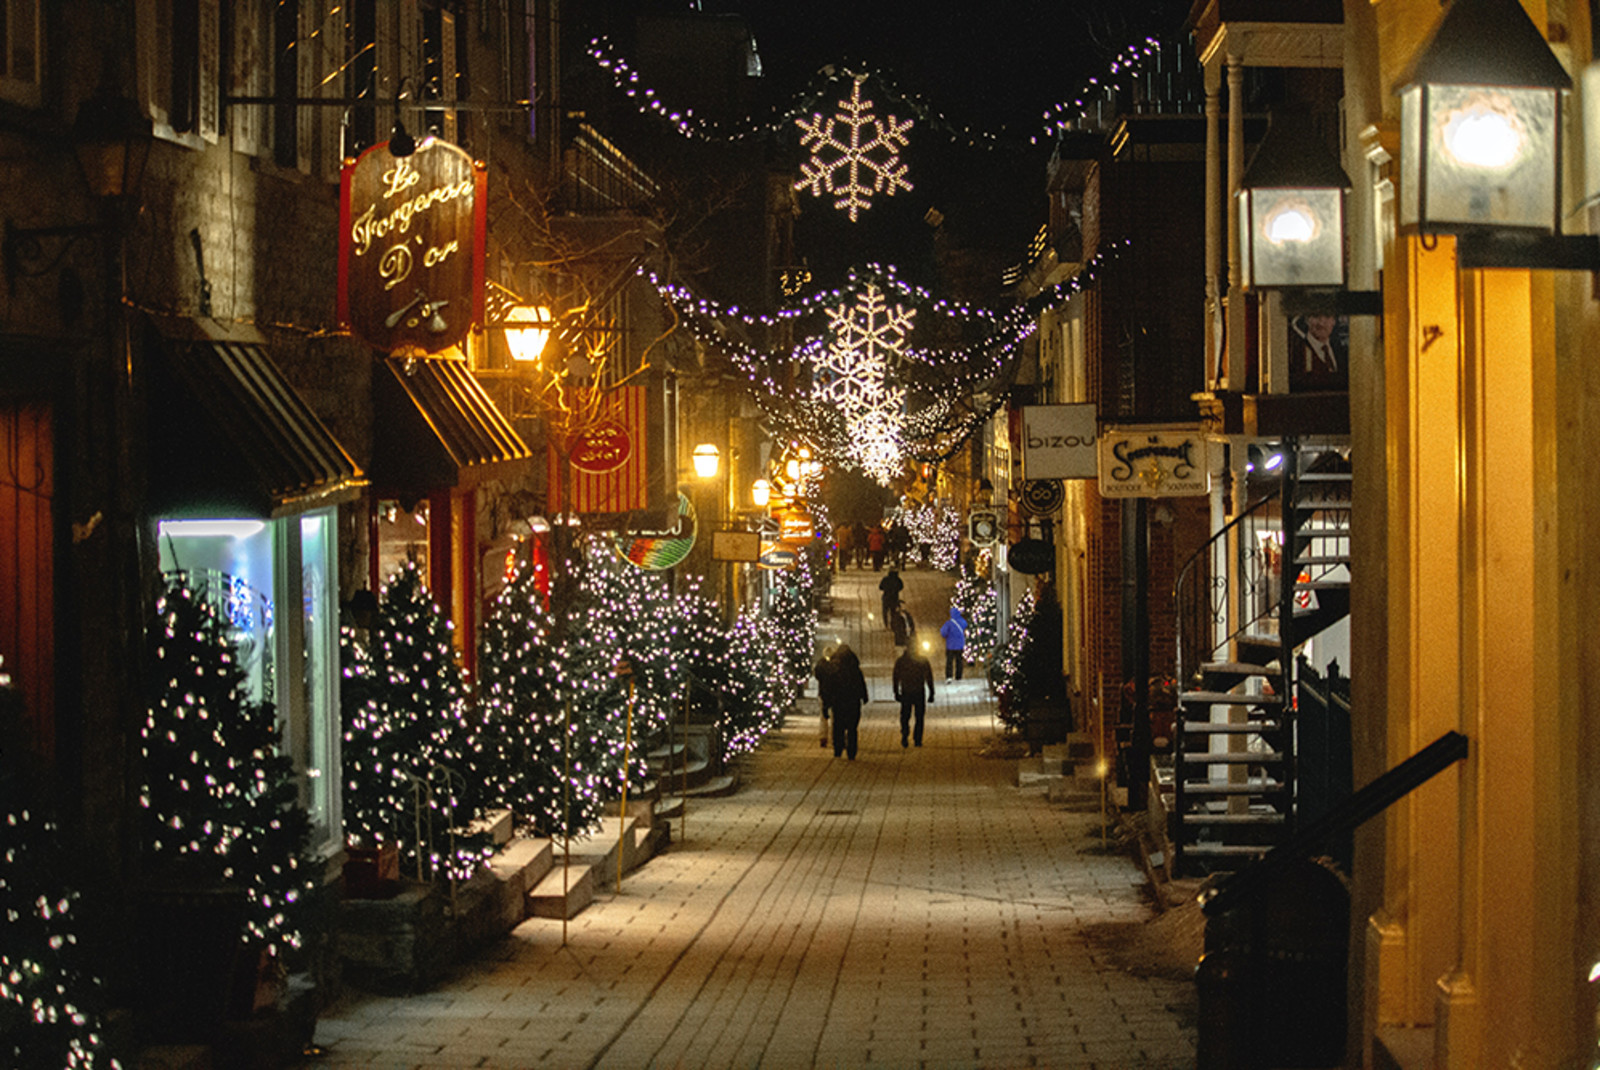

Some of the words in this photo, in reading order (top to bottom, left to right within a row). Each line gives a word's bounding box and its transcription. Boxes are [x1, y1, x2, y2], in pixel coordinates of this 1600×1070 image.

[383, 162, 420, 198] Le
[352, 181, 474, 256] Forgeron
[1027, 424, 1096, 449] bizou
